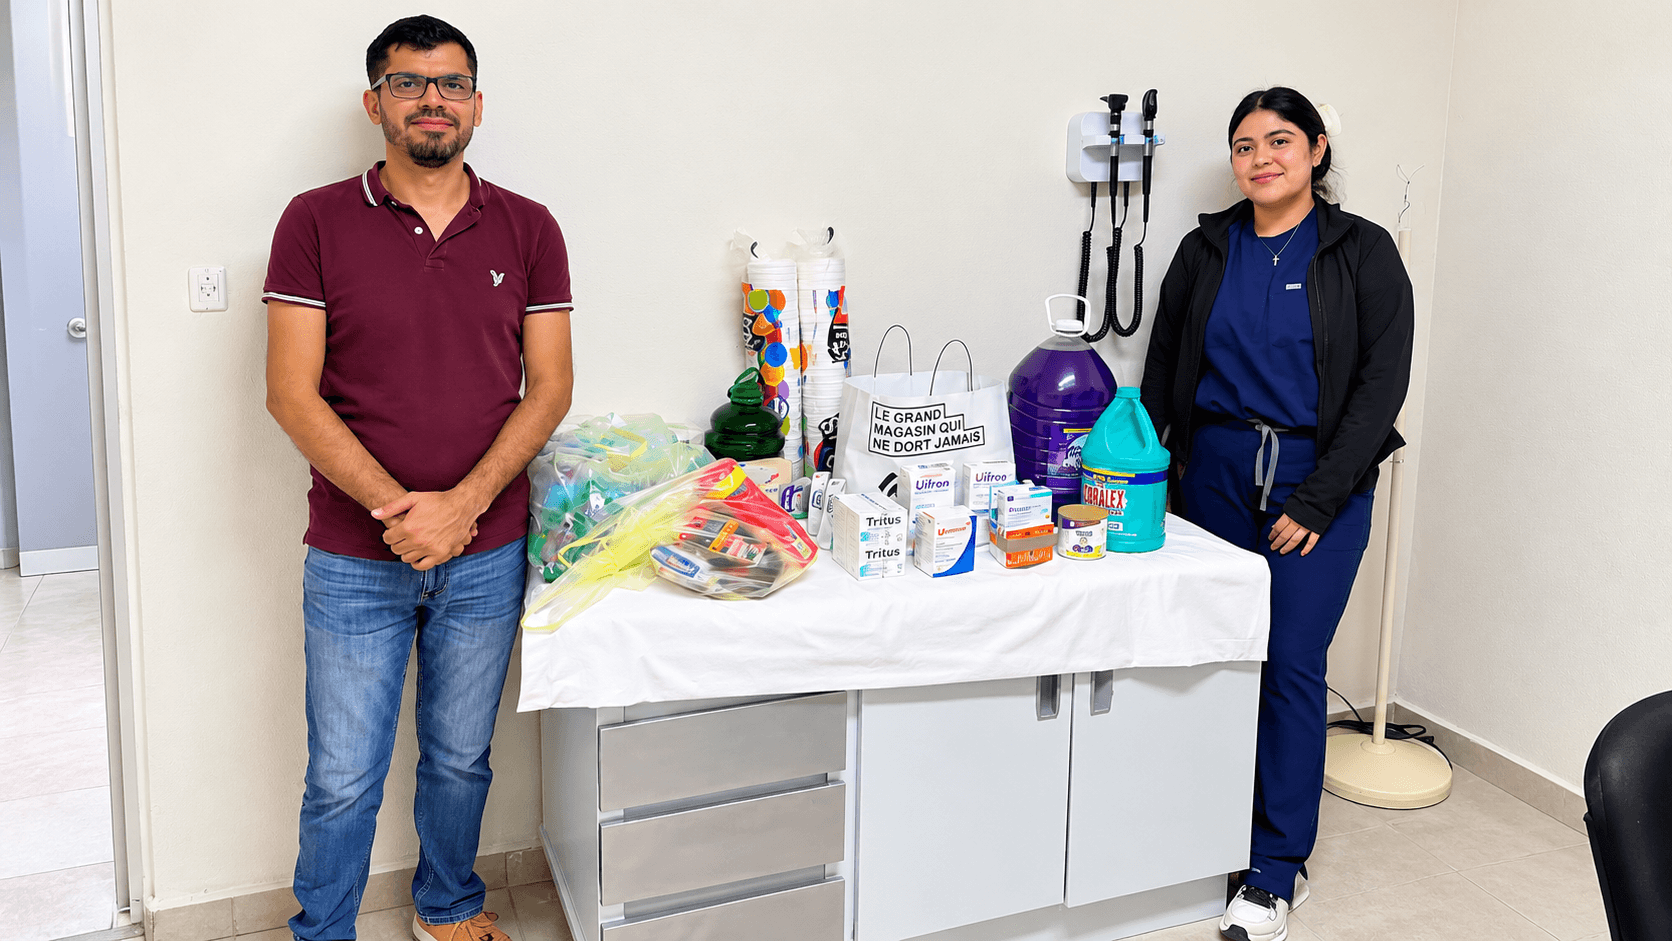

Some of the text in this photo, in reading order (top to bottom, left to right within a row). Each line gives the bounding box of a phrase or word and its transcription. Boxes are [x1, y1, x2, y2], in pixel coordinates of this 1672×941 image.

[874, 406, 941, 423] LE GRAND
[874, 419, 961, 438] MAGASIN QUI
[873, 431, 981, 452] NE DORT JAMAIS
[915, 479, 950, 490] Uifron
[865, 515, 902, 527] Tritus
[865, 548, 900, 559] Tritus
